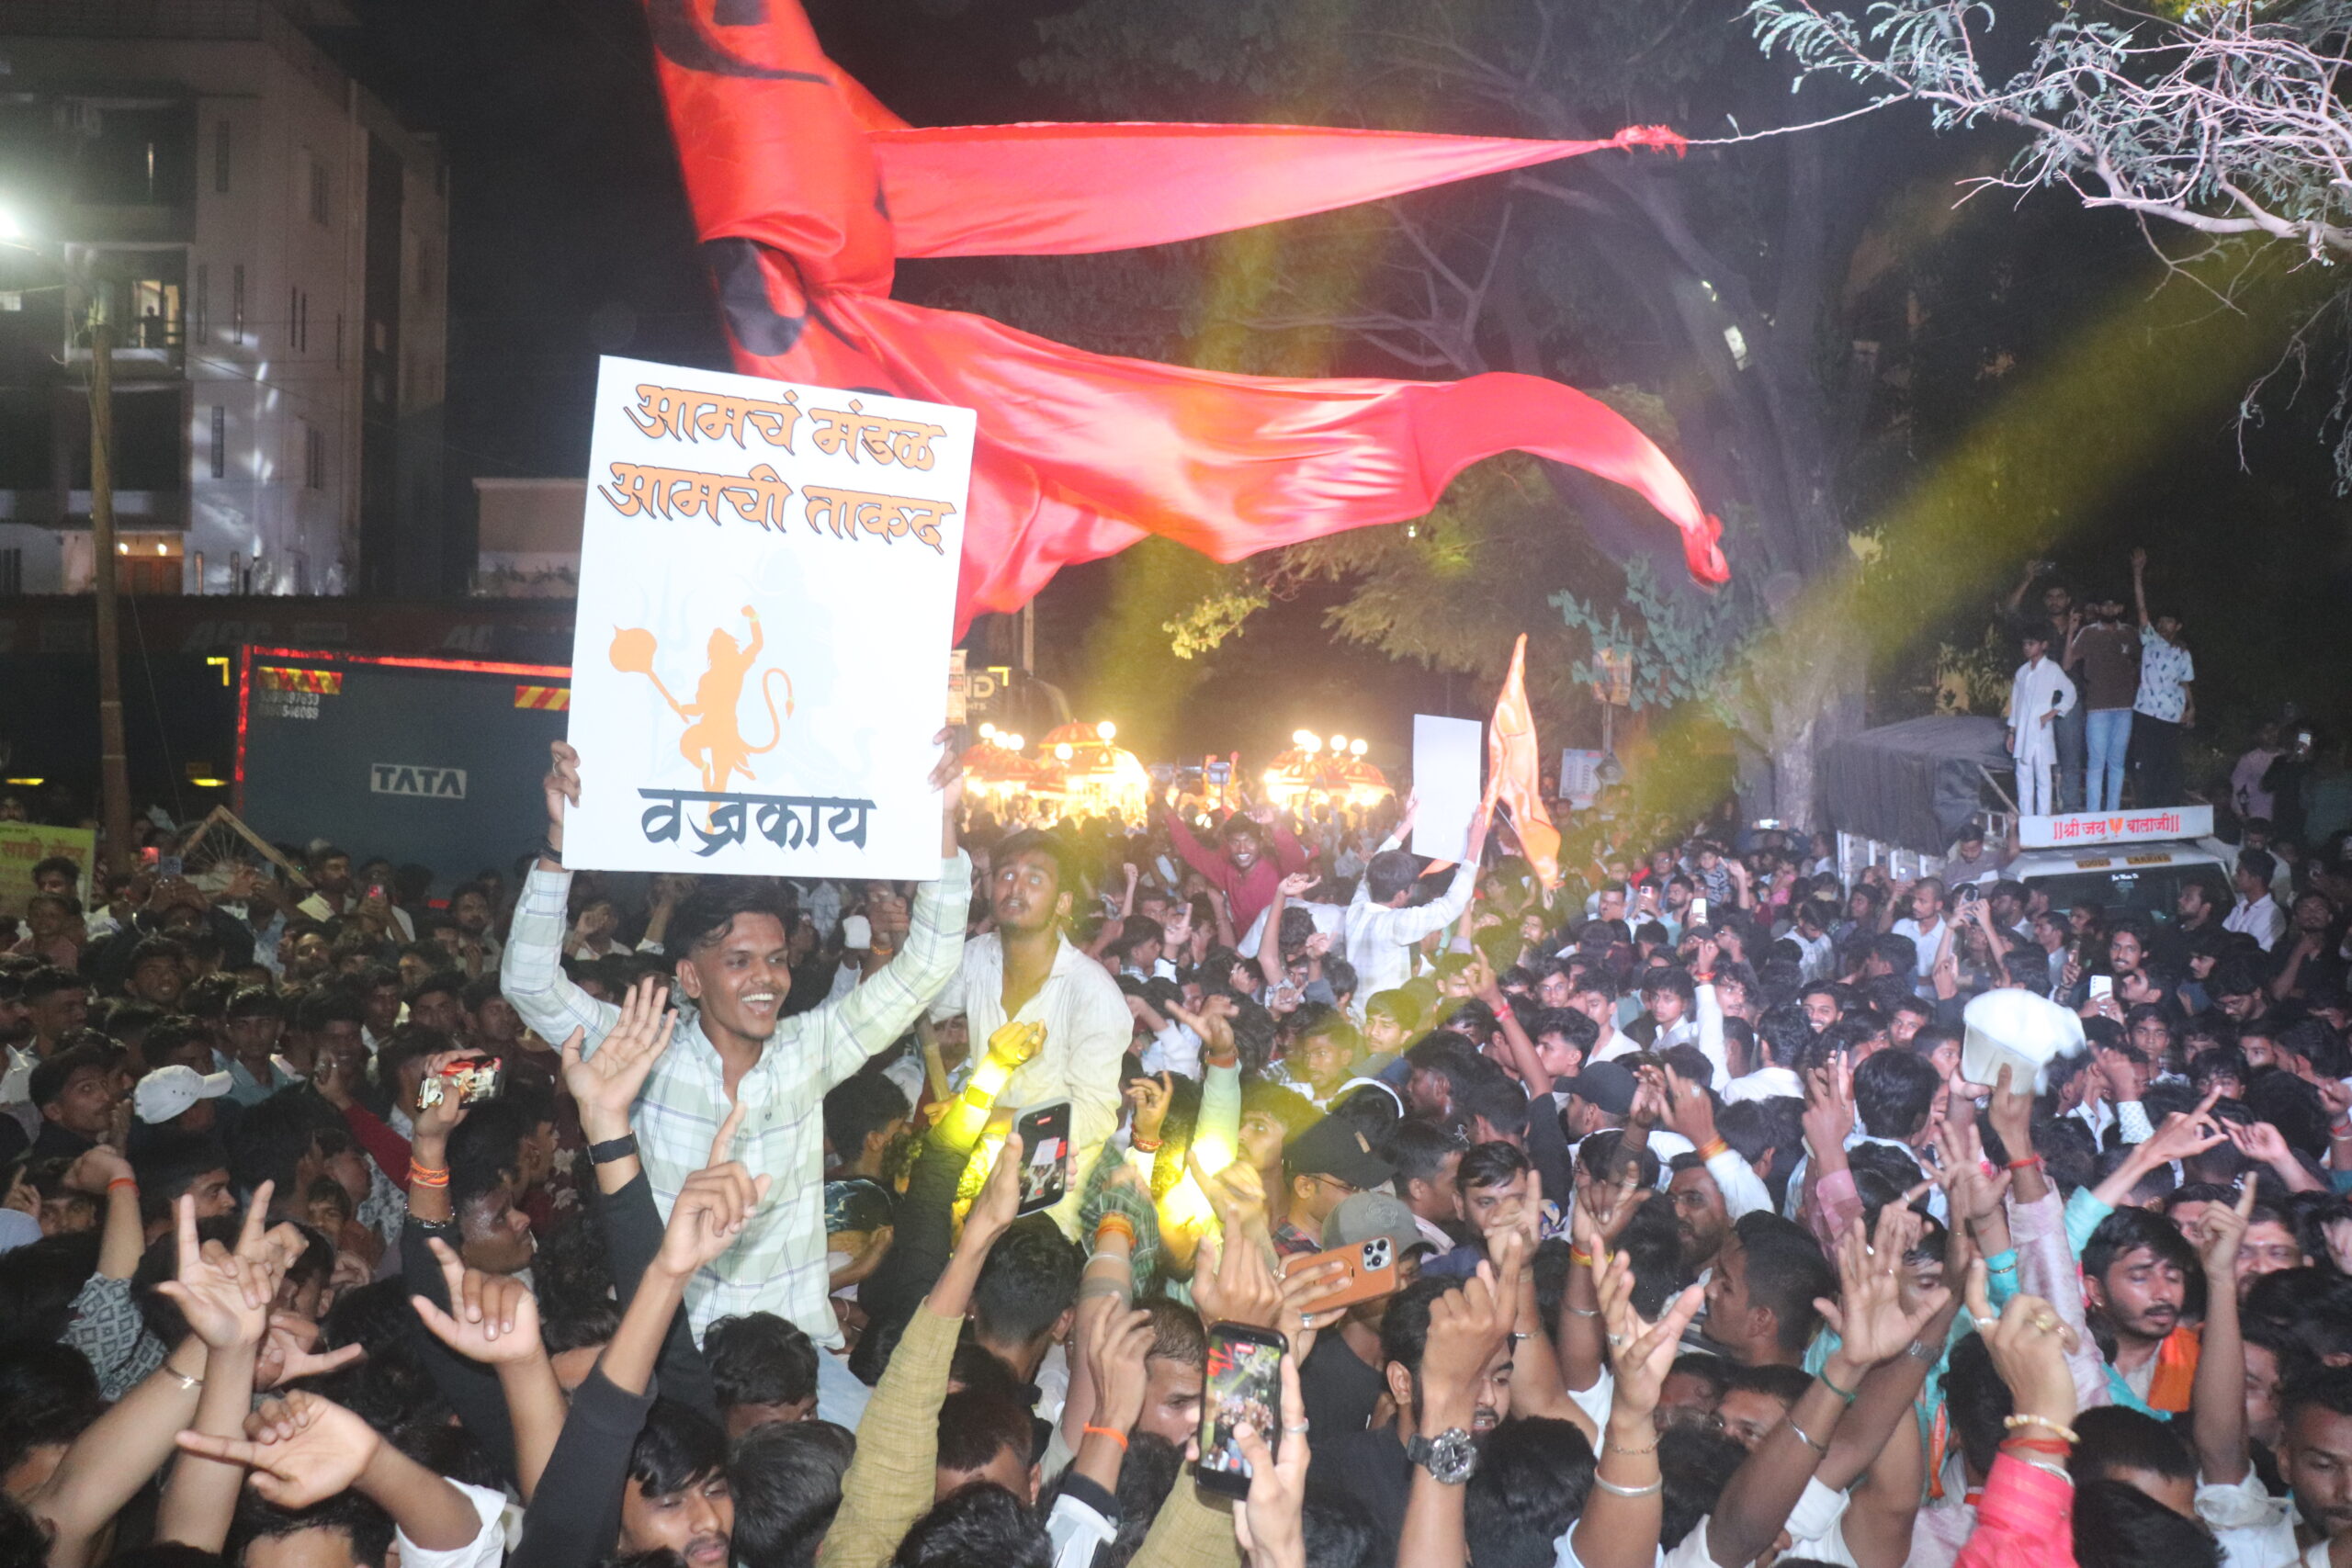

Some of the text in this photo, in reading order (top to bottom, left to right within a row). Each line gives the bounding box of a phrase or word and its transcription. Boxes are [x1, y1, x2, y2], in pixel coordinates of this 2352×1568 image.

[624, 384, 947, 471] आमचं मंडळ
[597, 462, 956, 555] आमची ताकद
[373, 765, 463, 796] TATA
[638, 788, 877, 857] वज्रकाय
[2082, 820, 2107, 835] जय
